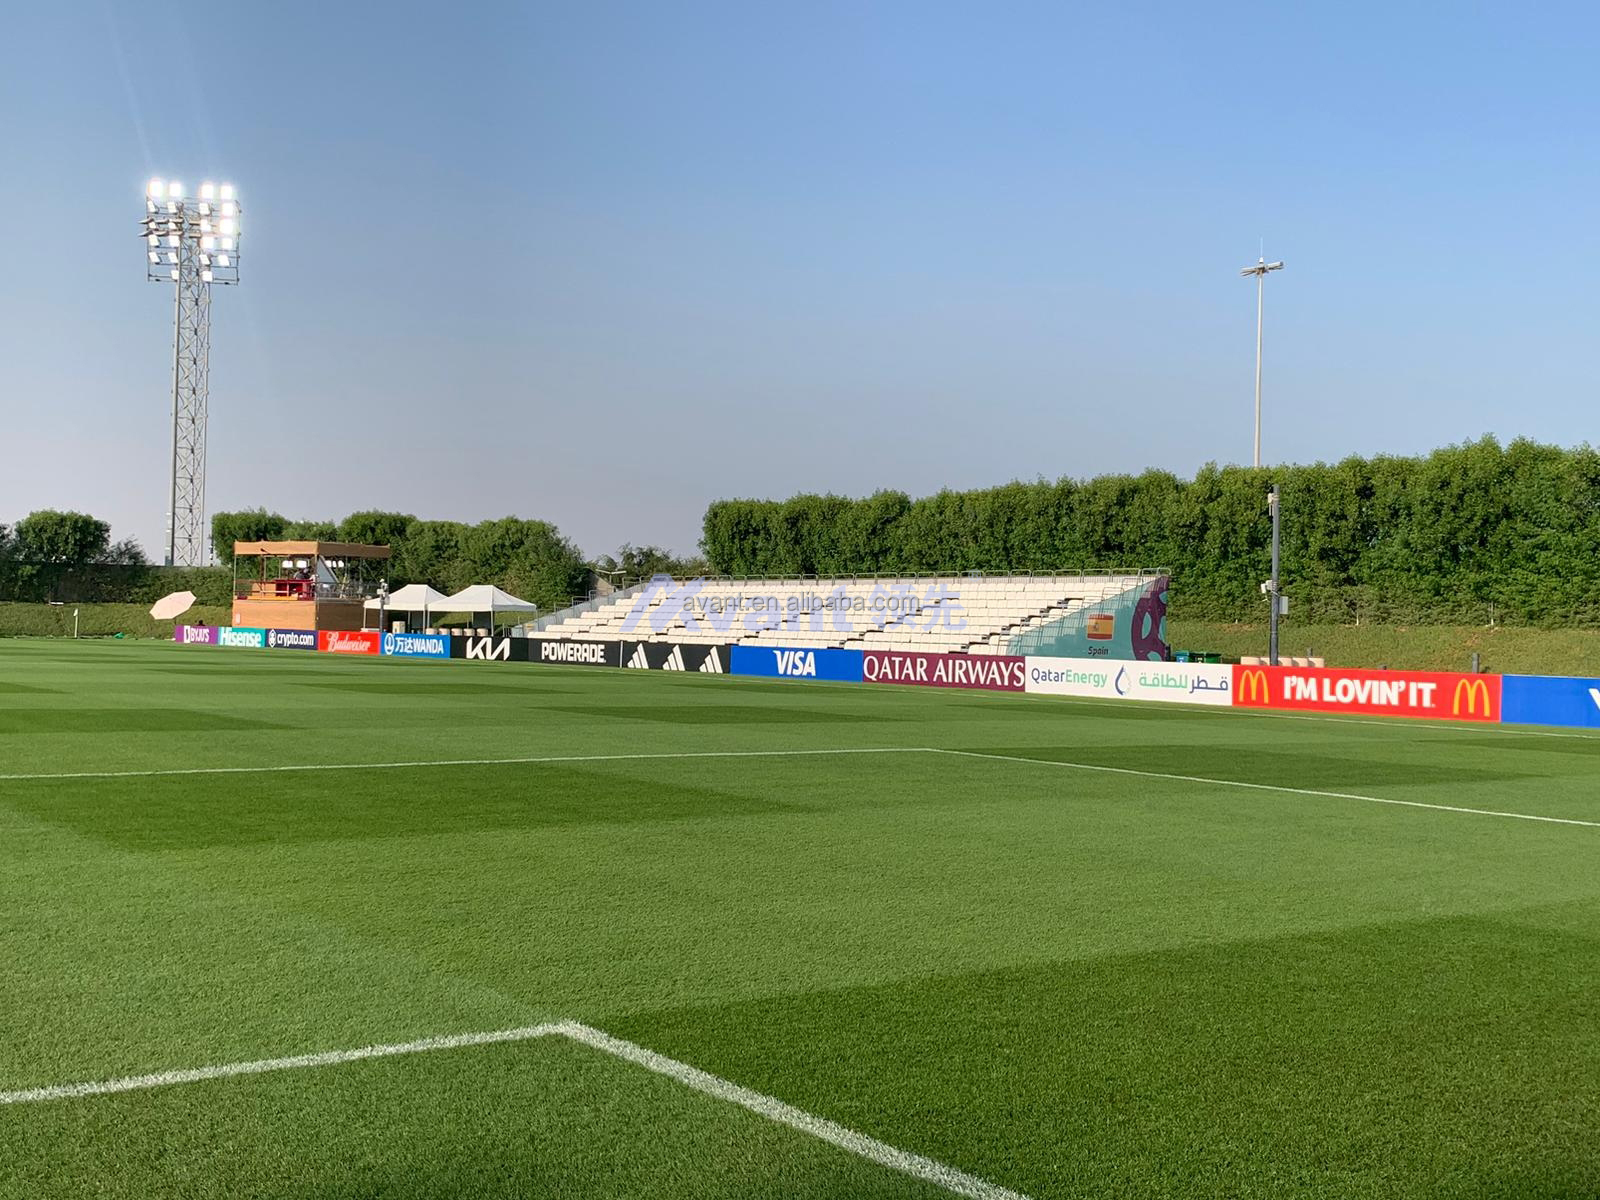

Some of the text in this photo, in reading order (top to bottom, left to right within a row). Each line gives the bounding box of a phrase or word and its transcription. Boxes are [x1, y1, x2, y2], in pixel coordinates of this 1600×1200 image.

[220, 627, 262, 647] Hisense
[277, 630, 314, 646] crypto.com
[327, 632, 371, 653] Budweiser
[467, 637, 510, 660] KIA
[1088, 646, 1109, 656] Spain
[773, 650, 816, 677] VISA
[863, 655, 1025, 688] QATAR AIRWAYS
[1031, 667, 1107, 687] QatarEnergy
[1139, 672, 1229, 693] قطر للطاقة
[1283, 675, 1317, 701] I'M
[1323, 678, 1405, 706] LOVIN'
